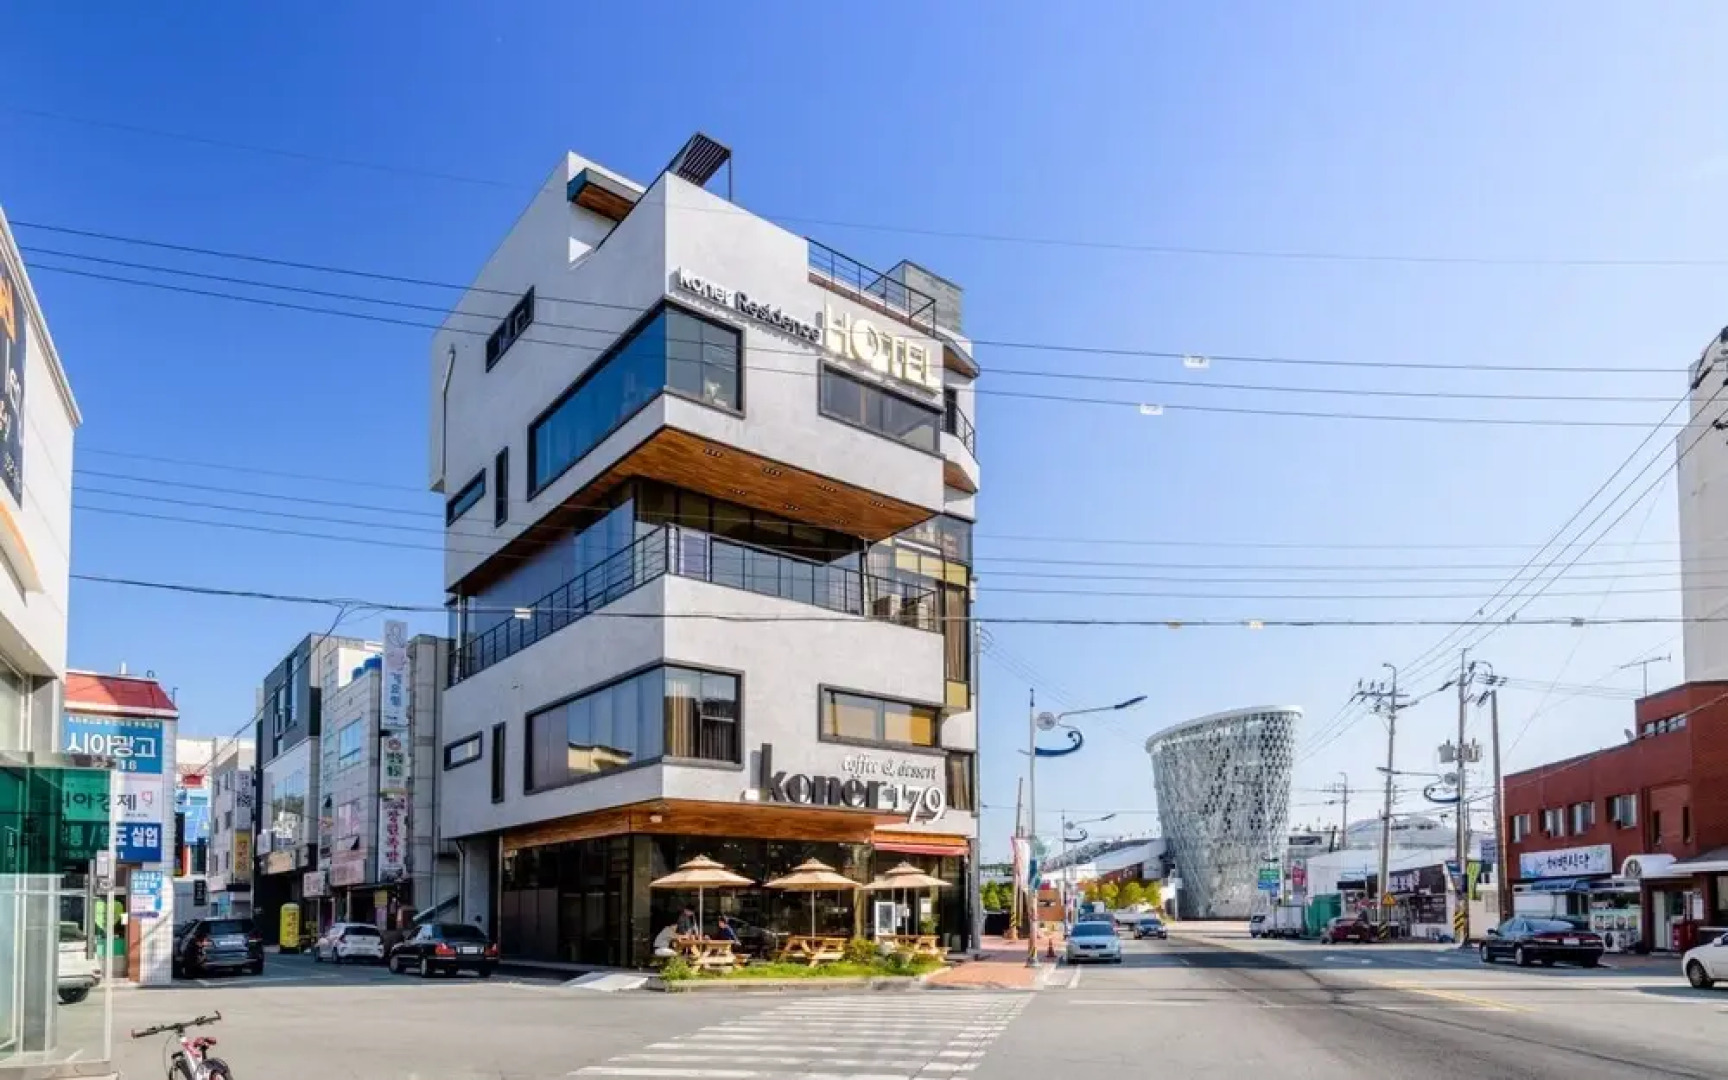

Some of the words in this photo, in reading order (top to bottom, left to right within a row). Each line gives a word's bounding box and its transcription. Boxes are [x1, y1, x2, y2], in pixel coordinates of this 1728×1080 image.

[677, 265, 732, 306] koner
[733, 290, 823, 344] Residence
[823, 303, 942, 389] HOTEL
[67, 732, 156, 758] 시아광고
[842, 753, 878, 779] coffee
[881, 757, 896, 777] &
[898, 760, 936, 780] dessert
